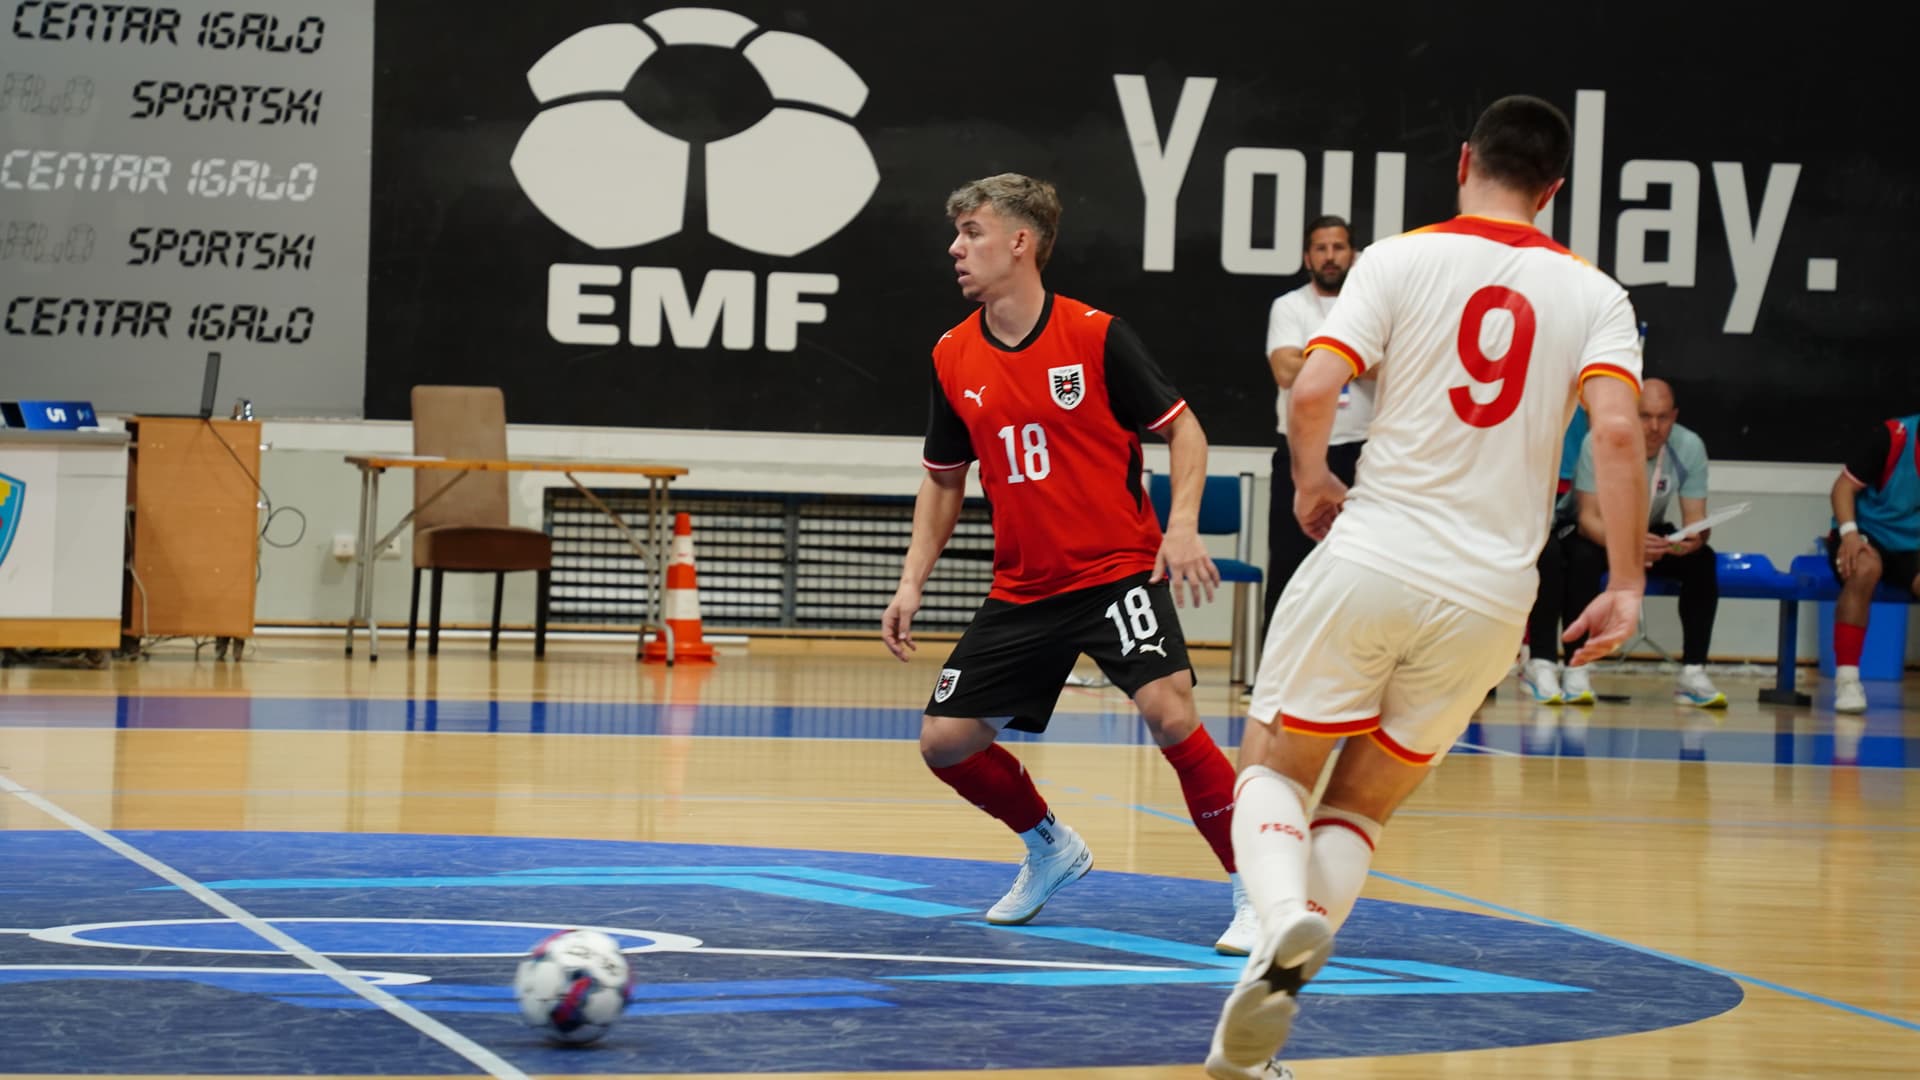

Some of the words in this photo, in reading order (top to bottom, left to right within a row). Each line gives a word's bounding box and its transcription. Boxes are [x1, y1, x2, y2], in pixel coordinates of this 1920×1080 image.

[12, 0, 181, 46] CENTAR
[130, 80, 323, 126] SPORTSKI
[1, 149, 171, 195] CENTAR
[1533, 89, 1837, 334] lay.
[126, 227, 315, 271] SPORTSKI
[3, 295, 172, 339] CENTAR
[547, 263, 839, 352] EMF
[1448, 284, 1537, 429] 9
[998, 422, 1052, 485] 18
[1104, 585, 1159, 657] 18
